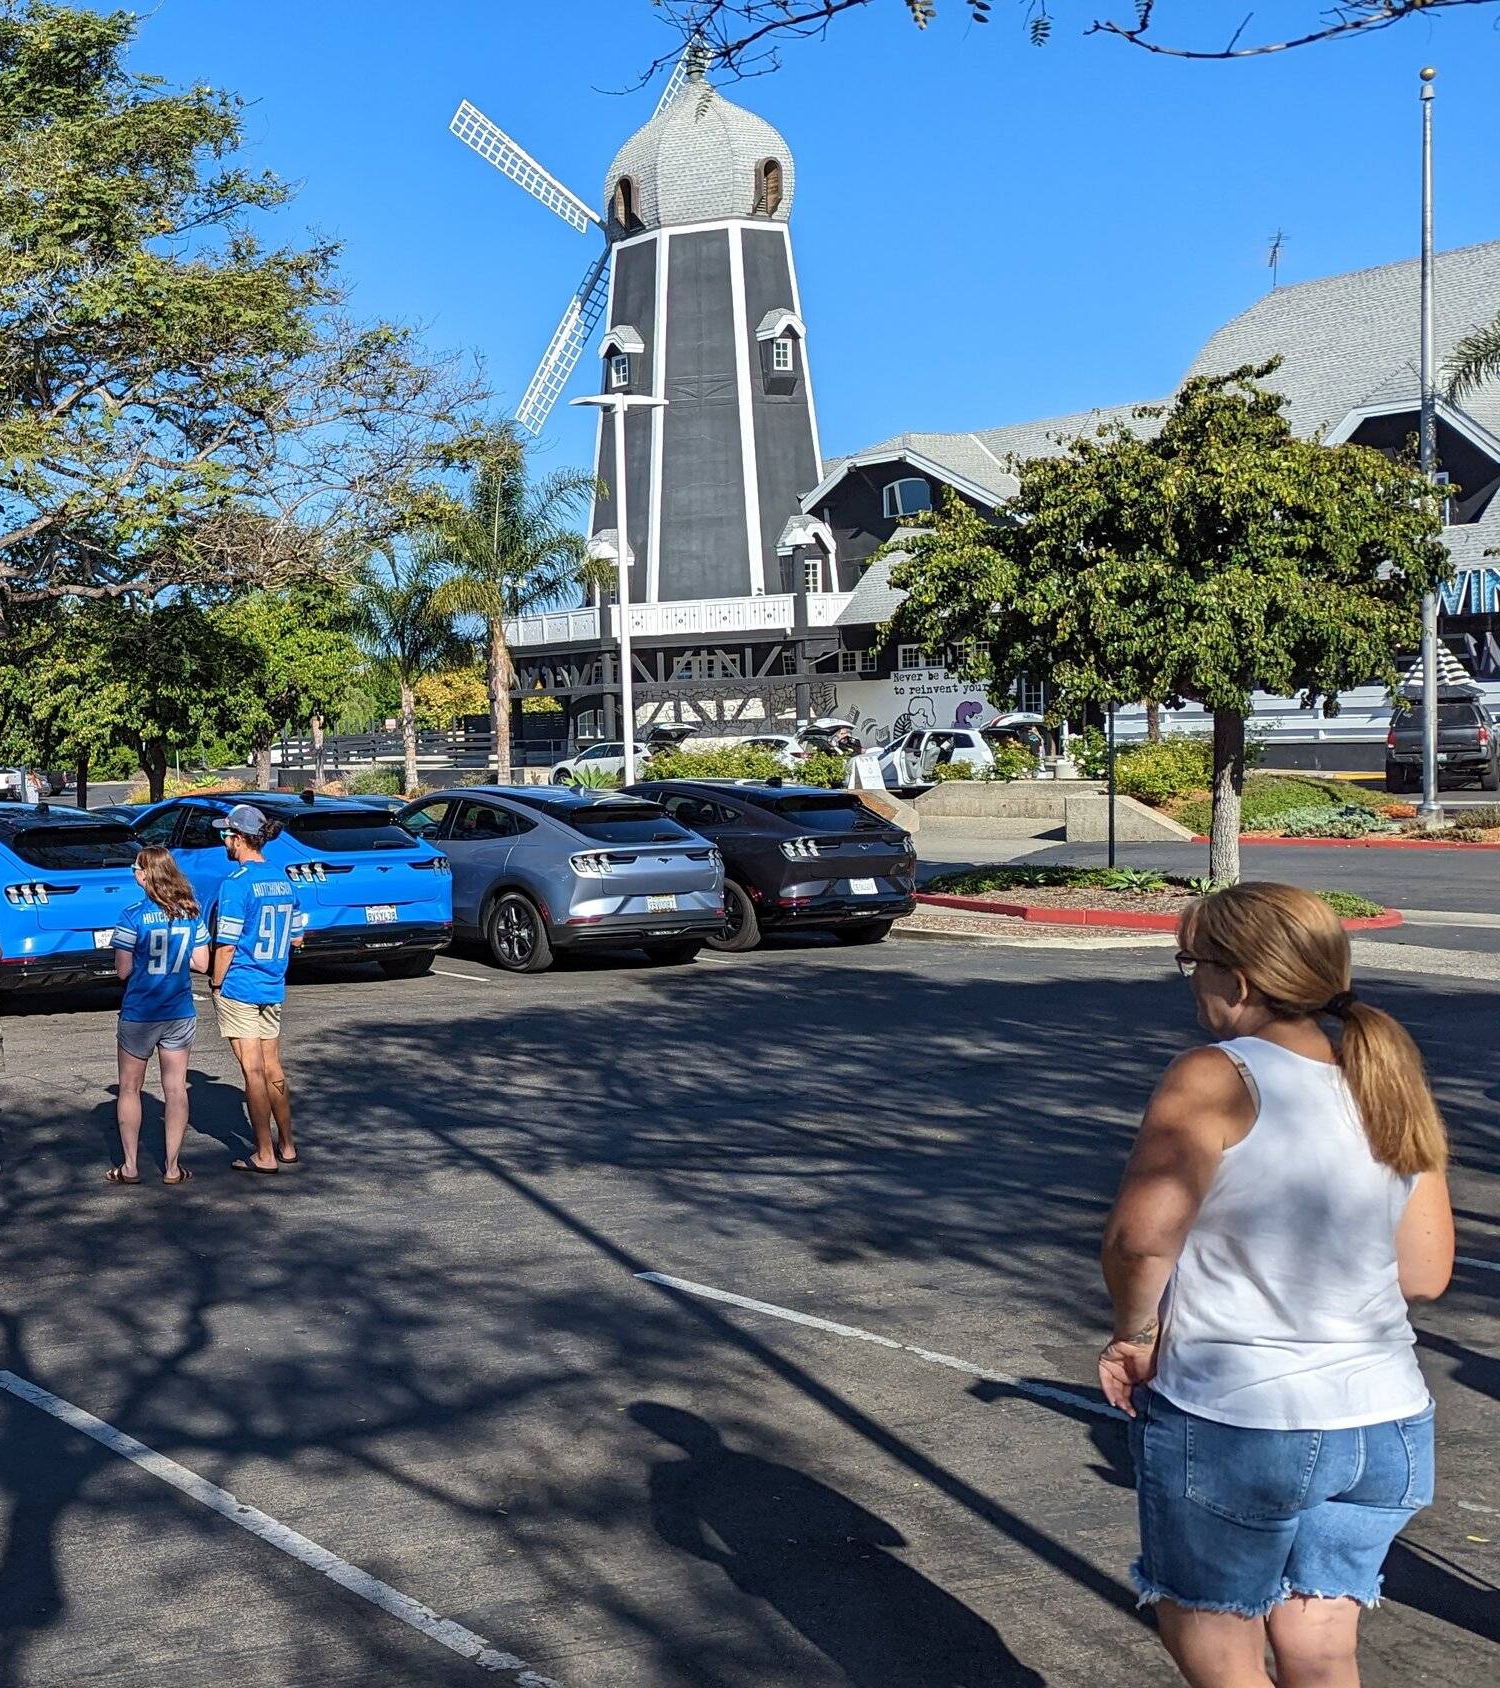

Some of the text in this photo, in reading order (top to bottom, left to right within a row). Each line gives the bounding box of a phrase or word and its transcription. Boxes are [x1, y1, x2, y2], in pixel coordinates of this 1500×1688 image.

[893, 672, 923, 683] Never
[928, 670, 939, 681] be
[894, 685, 905, 695] to
[908, 684, 959, 695] reinvent
[254, 903, 293, 960] 97
[148, 926, 191, 975] 97
